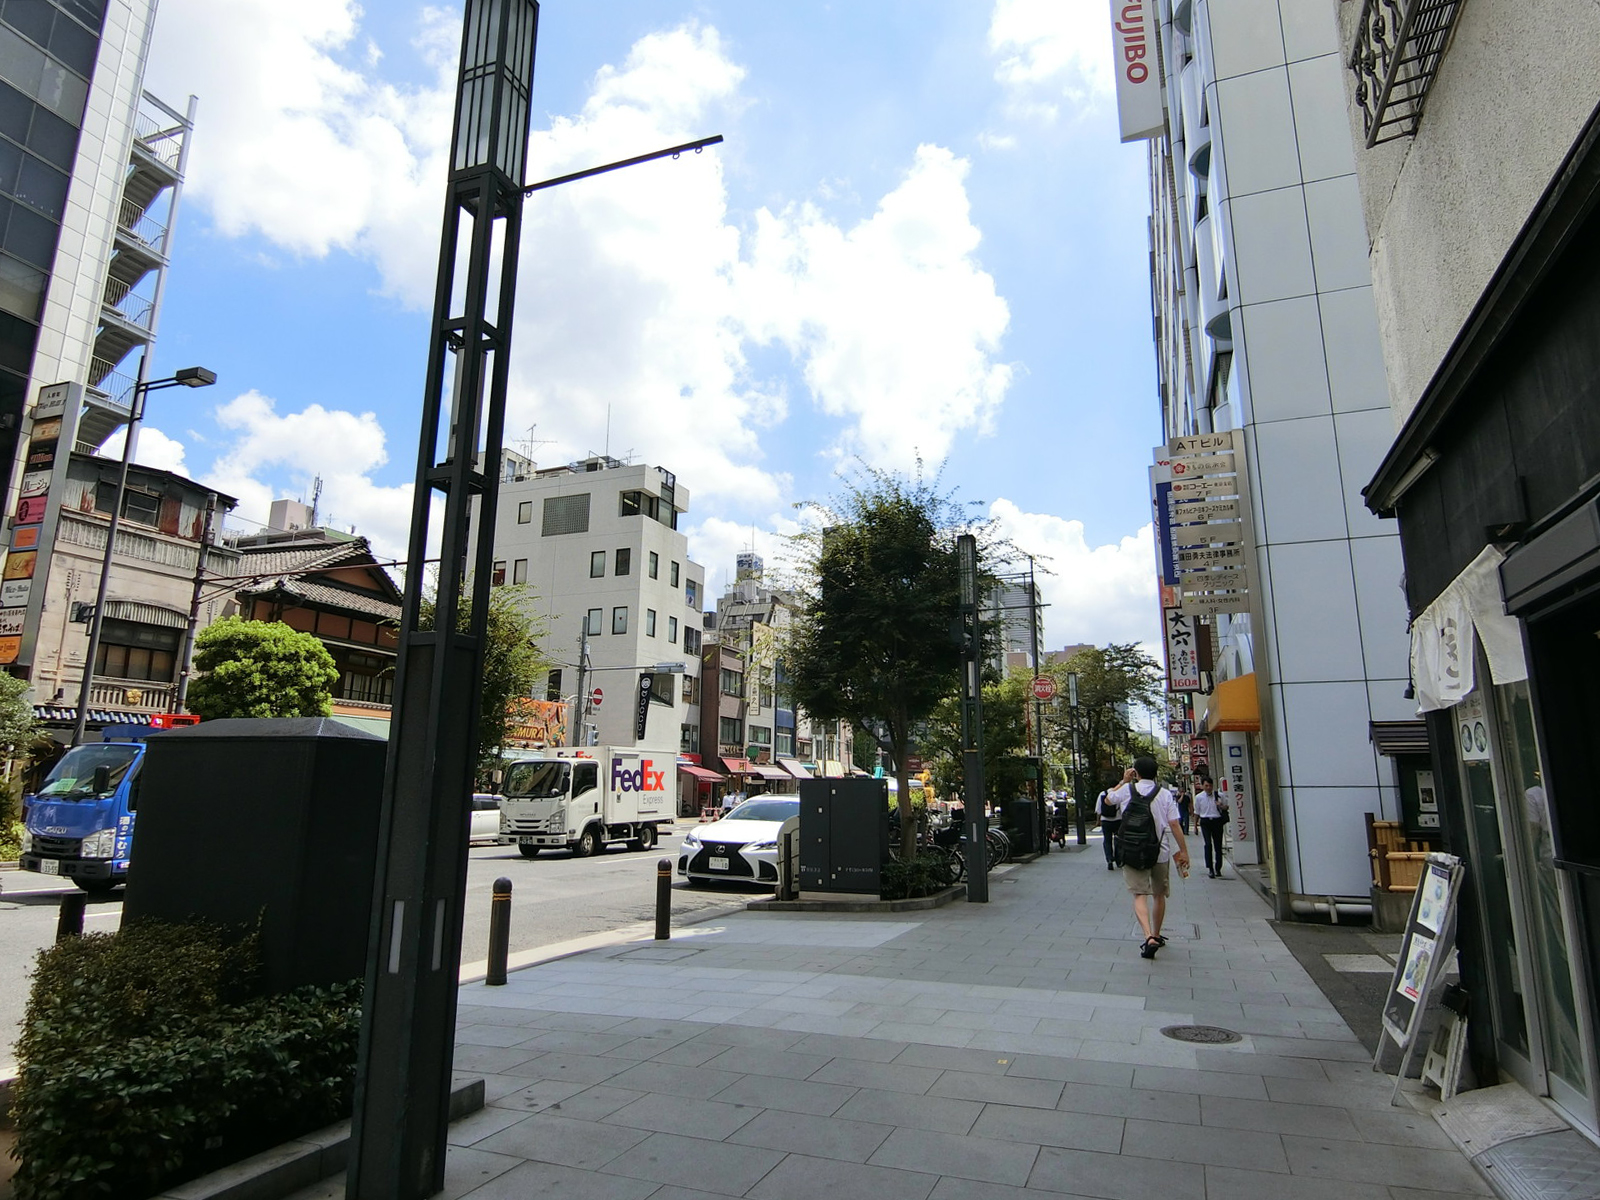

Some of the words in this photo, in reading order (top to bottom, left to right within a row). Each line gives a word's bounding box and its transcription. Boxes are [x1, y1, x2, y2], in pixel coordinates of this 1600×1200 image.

[1115, 0, 1148, 84] UJIBO
[1176, 437, 1224, 451] ATビル
[611, 758, 665, 792] FedEx
[643, 794, 664, 806] Express
